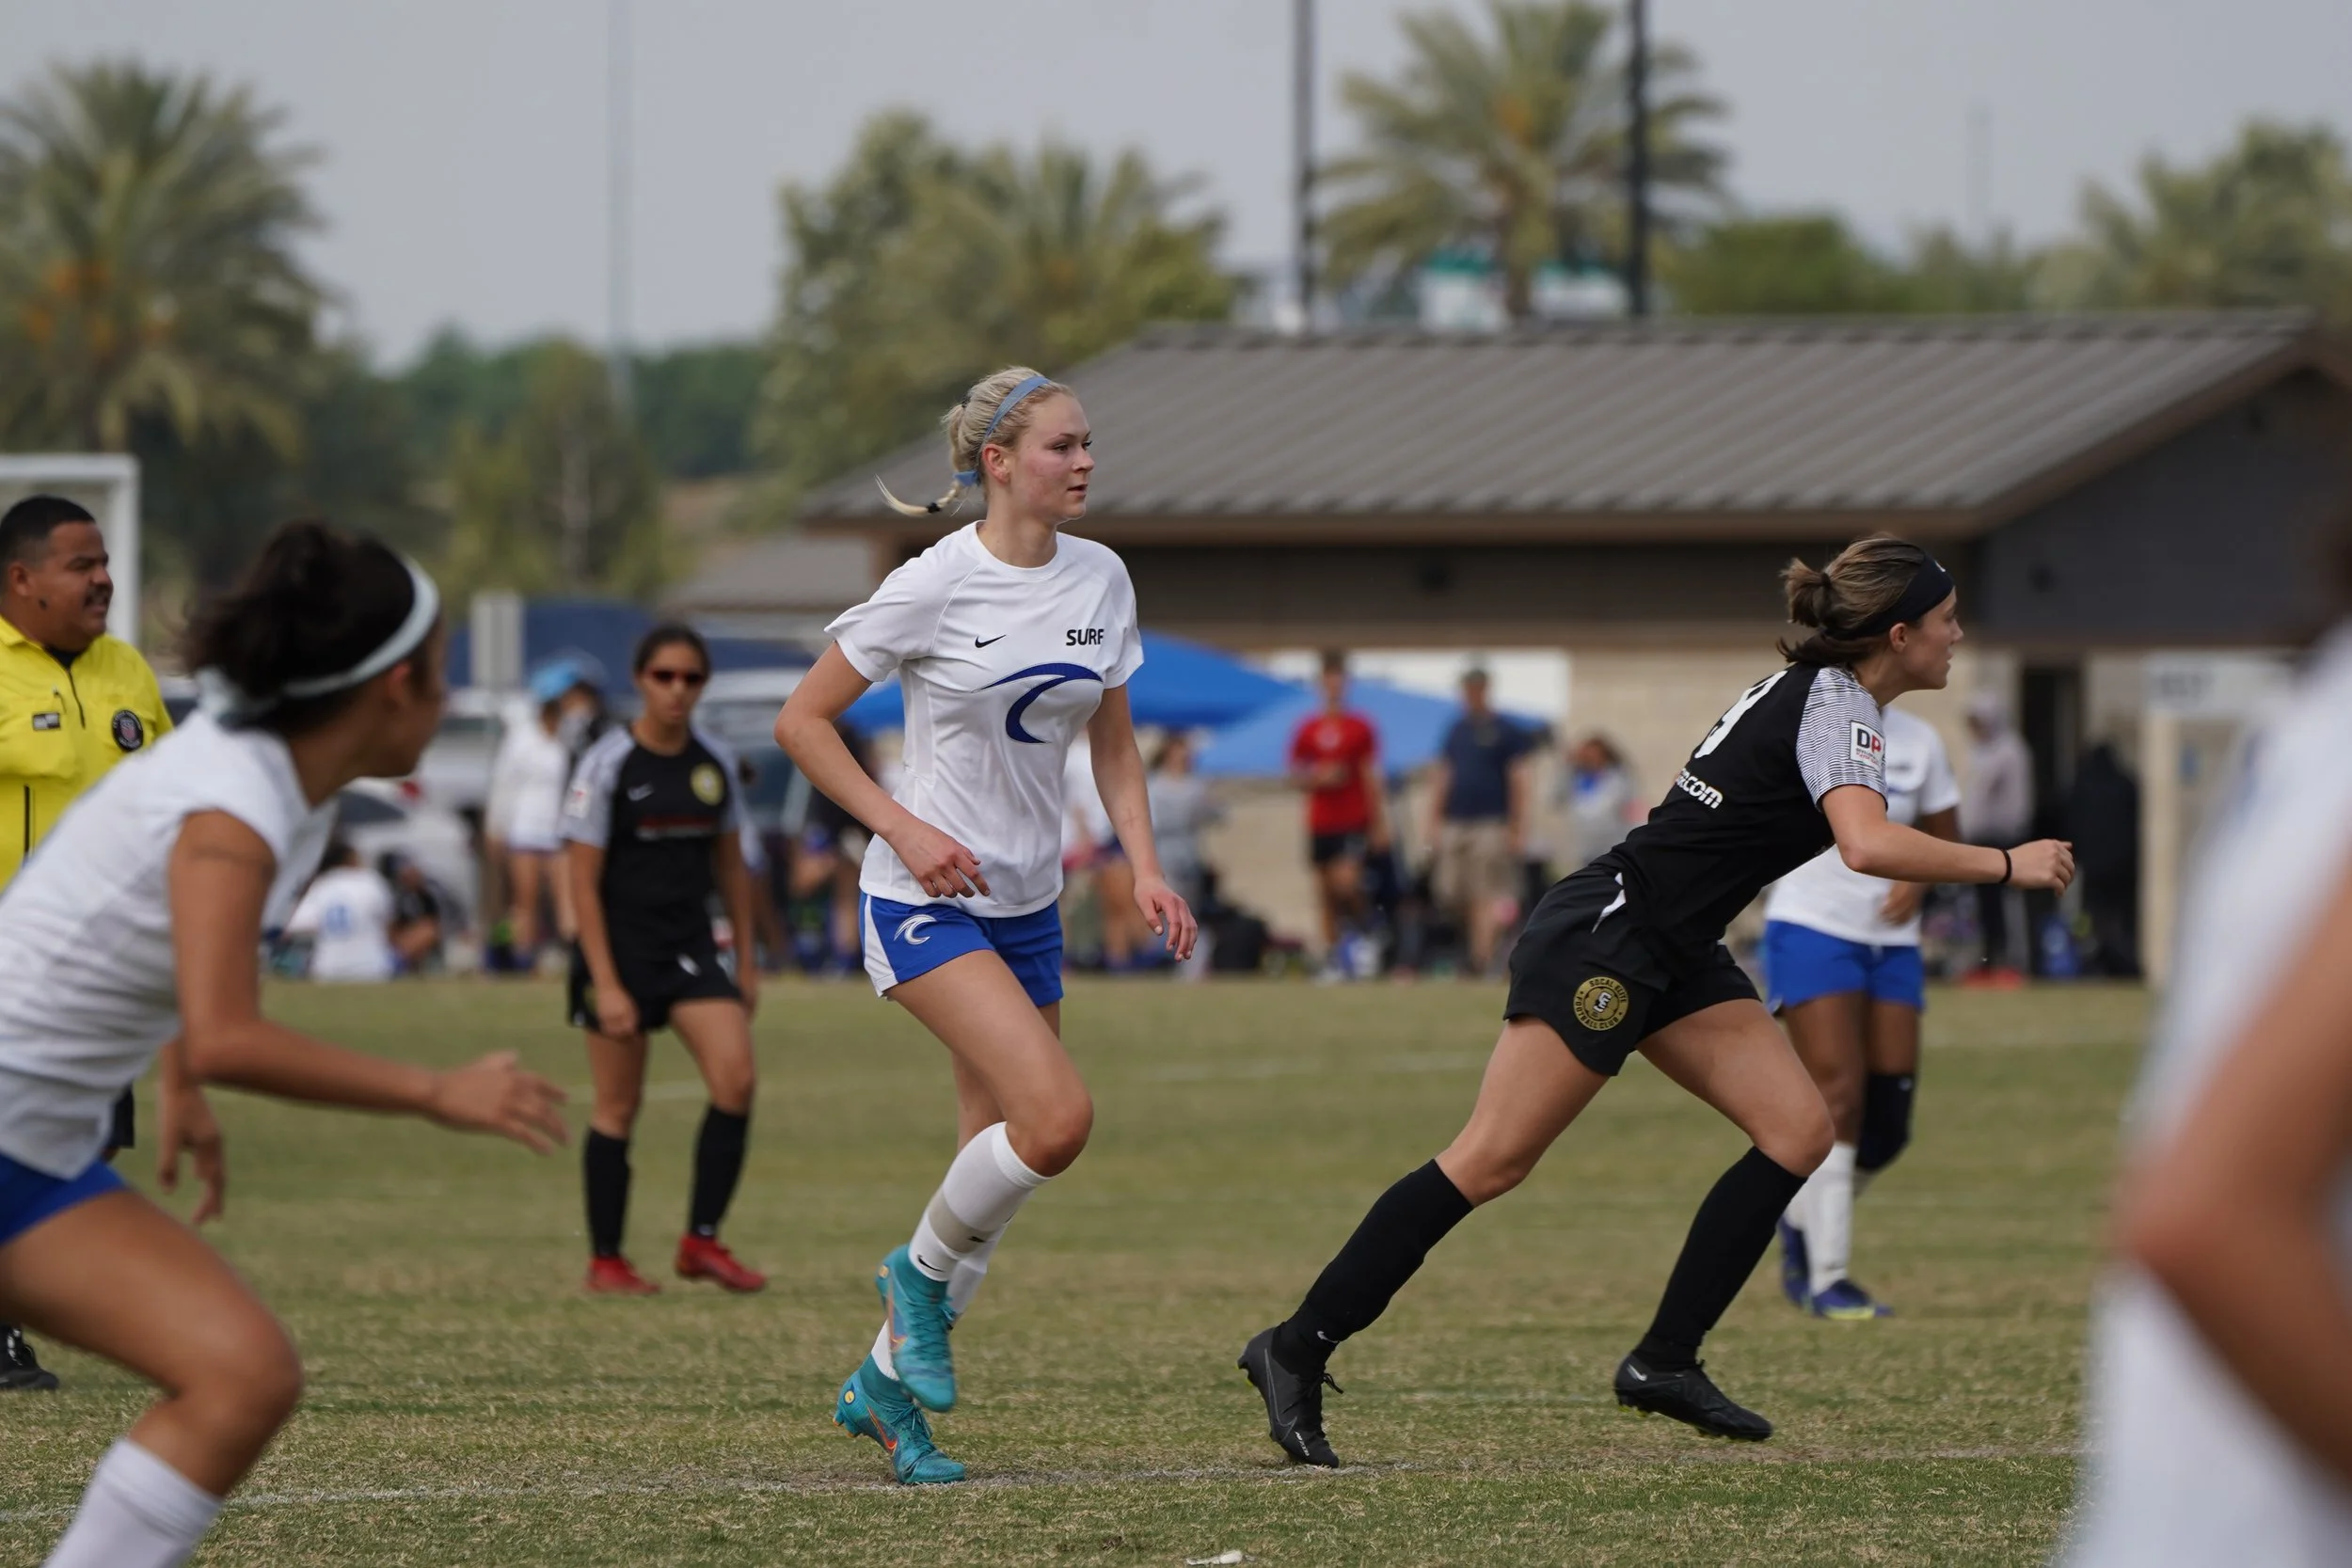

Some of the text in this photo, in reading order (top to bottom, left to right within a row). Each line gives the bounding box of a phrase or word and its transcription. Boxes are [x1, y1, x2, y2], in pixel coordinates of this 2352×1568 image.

[1066, 628, 1104, 646] SURF
[1857, 728, 1882, 753] DP
[1589, 978, 1614, 988] SOCAL
[1614, 985, 1627, 1003] ELITE
[1576, 996, 1598, 1029] FOOTBALL
[1599, 1016, 1619, 1029] CLUB
